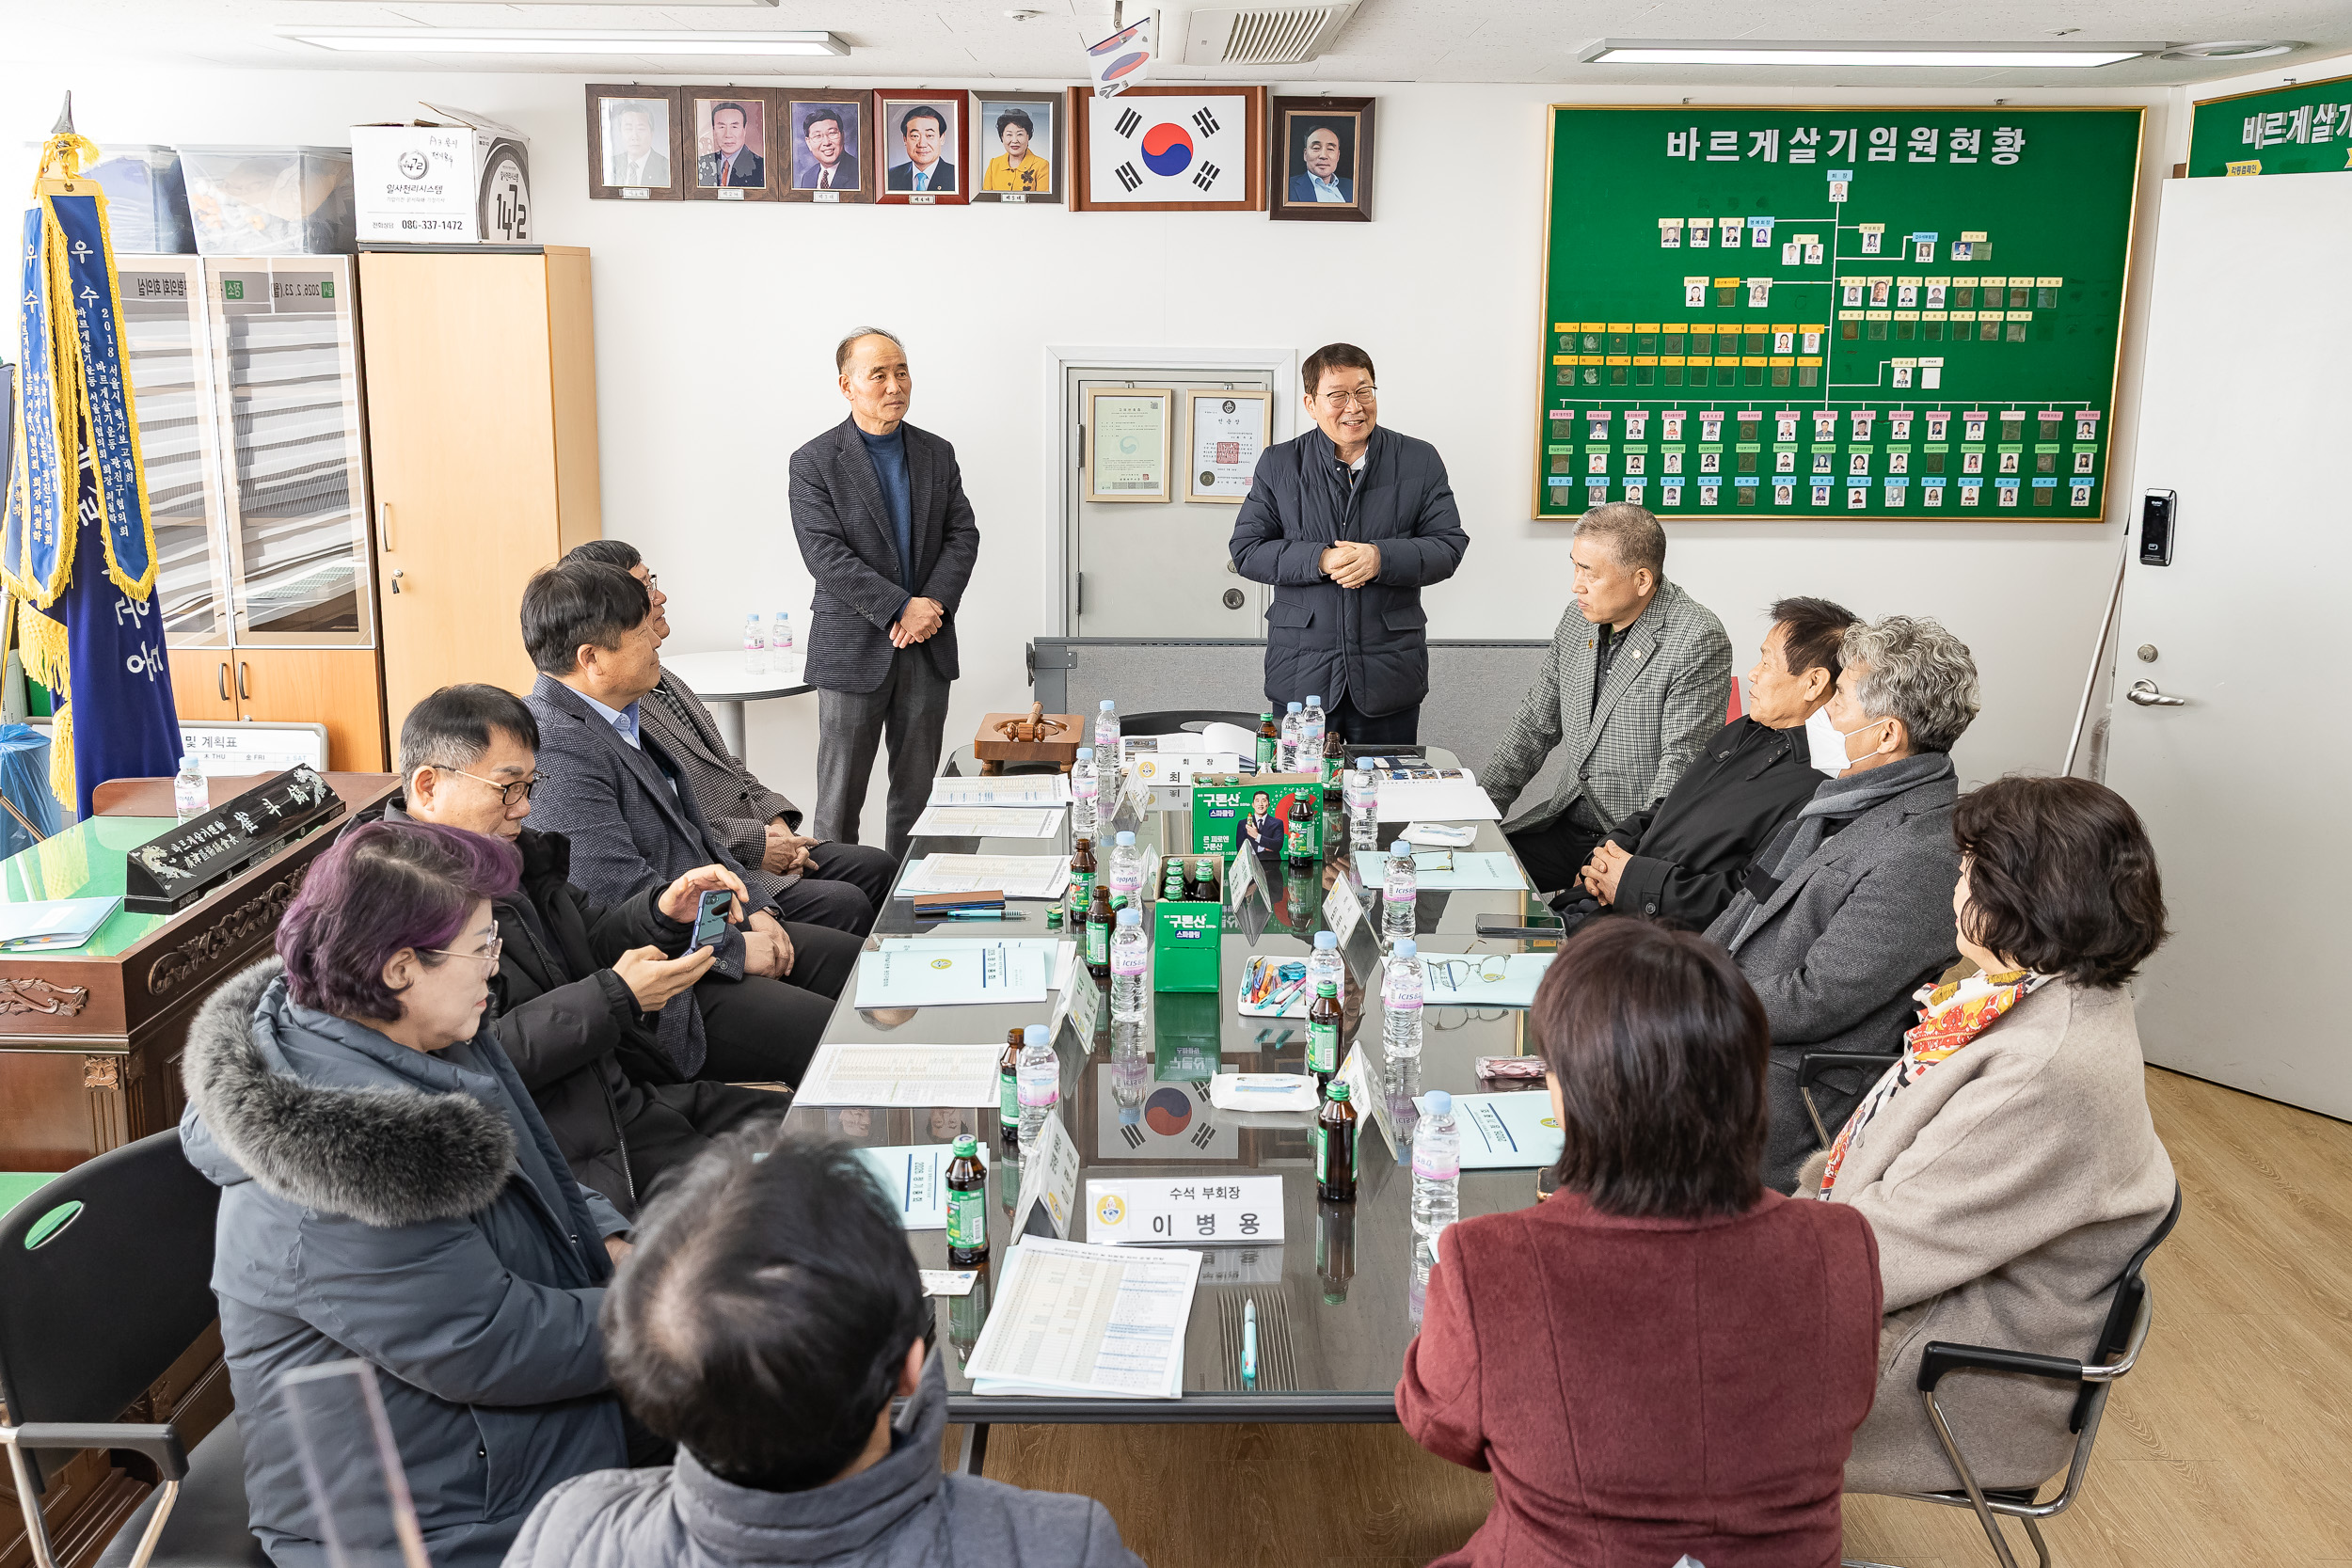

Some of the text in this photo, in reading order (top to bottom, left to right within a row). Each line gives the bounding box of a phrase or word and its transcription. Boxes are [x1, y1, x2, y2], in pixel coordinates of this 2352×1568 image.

[1666, 125, 2027, 166] 바르게살기임원현황
[185, 736, 238, 748] 및 계획표
[1169, 1186, 1241, 1200] 수석 부회장
